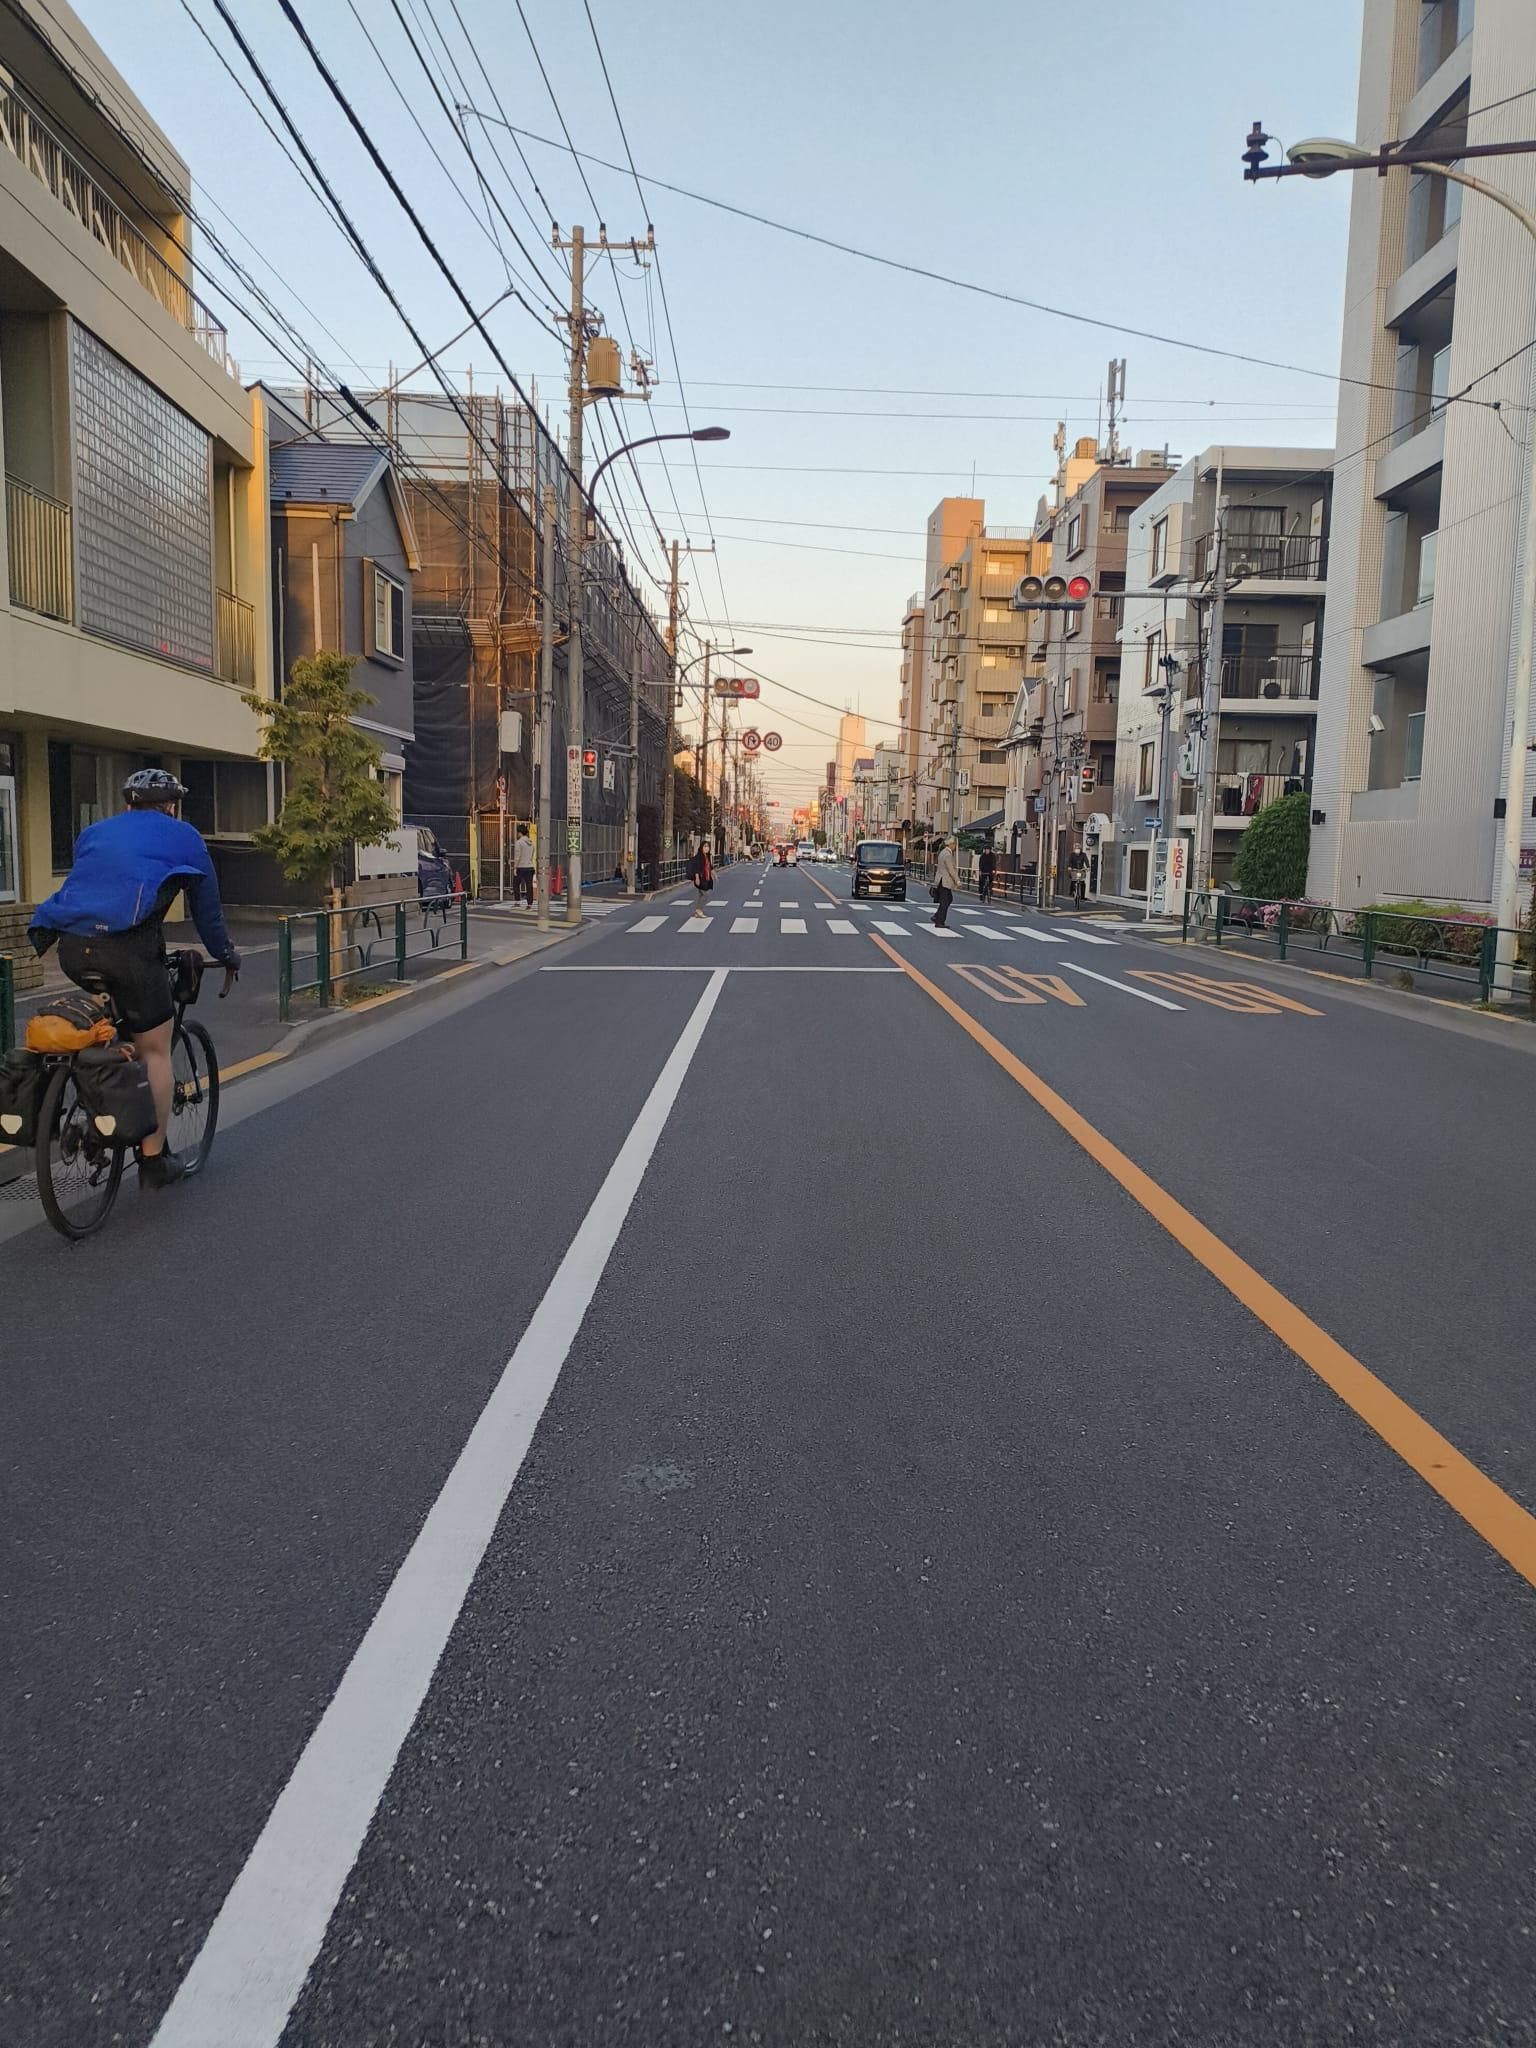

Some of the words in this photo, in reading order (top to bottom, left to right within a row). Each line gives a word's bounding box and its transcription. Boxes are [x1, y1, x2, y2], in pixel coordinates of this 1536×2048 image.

[767, 737, 778, 747] 40
[1175, 848, 1184, 879] DyDo
[946, 964, 1088, 1006] 40
[1124, 970, 1327, 1016] 40
